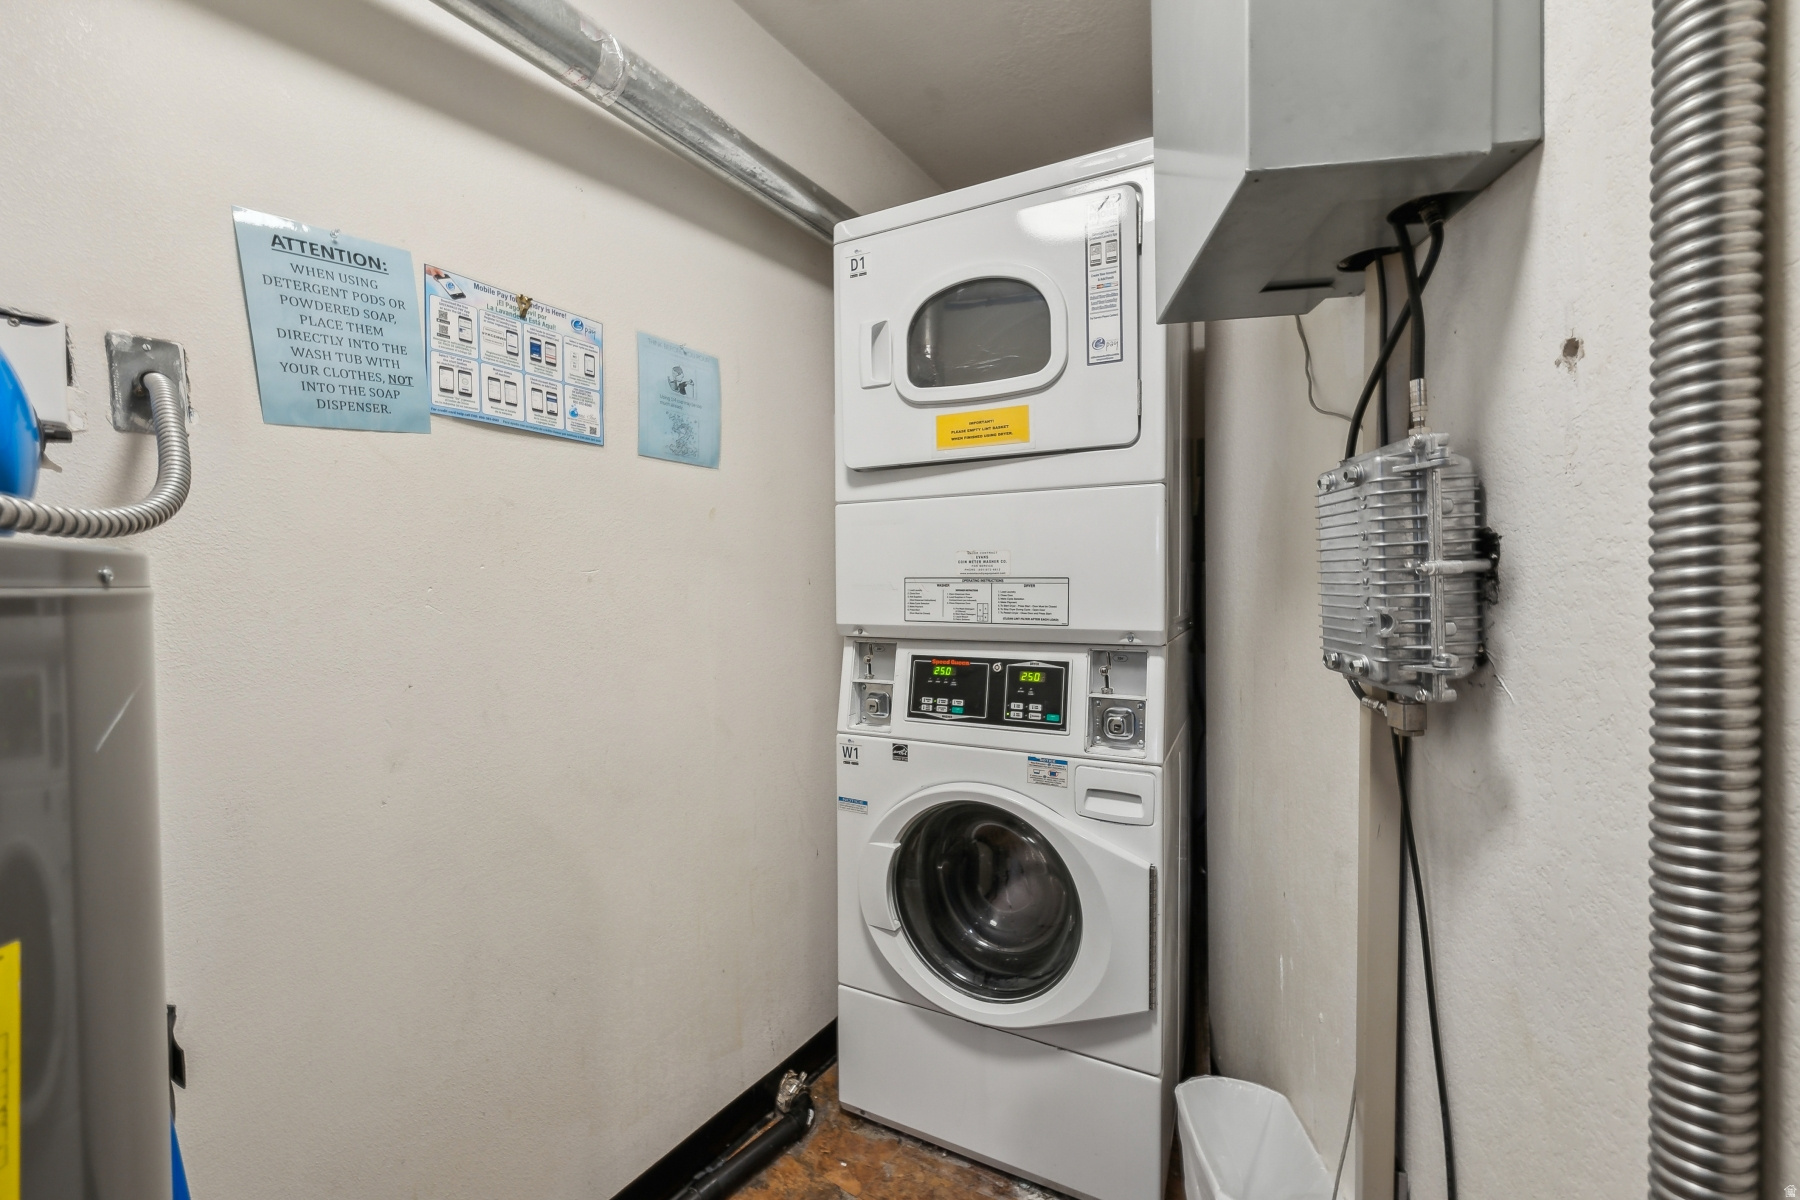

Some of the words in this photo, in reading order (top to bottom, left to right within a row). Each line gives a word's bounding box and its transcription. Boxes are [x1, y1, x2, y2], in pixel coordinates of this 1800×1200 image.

[271, 234, 388, 274] ATTENTION:
[851, 256, 864, 271] D1
[290, 263, 335, 281] WHEN
[339, 274, 378, 289] USING
[262, 274, 348, 300] DETERGENT
[352, 292, 386, 306] PODS
[388, 299, 406, 310] OR
[474, 283, 496, 296] Mobile
[497, 291, 508, 300] Pay
[552, 310, 566, 319] Here!
[280, 294, 360, 317] POWDERED
[364, 310, 397, 325] SOAP,
[506, 303, 520, 312] Pago
[300, 314, 343, 330] PLACE
[346, 322, 384, 336] THEM
[529, 318, 540, 326] Está
[276, 328, 344, 347] DIRECTLY
[348, 338, 379, 351] INTO
[382, 343, 408, 356] THE
[1106, 340, 1118, 351] pay
[290, 346, 332, 361] WASH
[335, 352, 362, 364] TUB
[366, 356, 400, 369] WITH
[280, 362, 320, 376] YOUR
[323, 367, 386, 384] CLOTHES,
[388, 374, 414, 387] NOT
[301, 381, 335, 394] INTO
[339, 385, 366, 396] THE
[369, 388, 400, 399] SOAP
[660, 394, 670, 402] Using
[316, 399, 392, 414] DISPENSER.
[842, 746, 858, 759] W1
